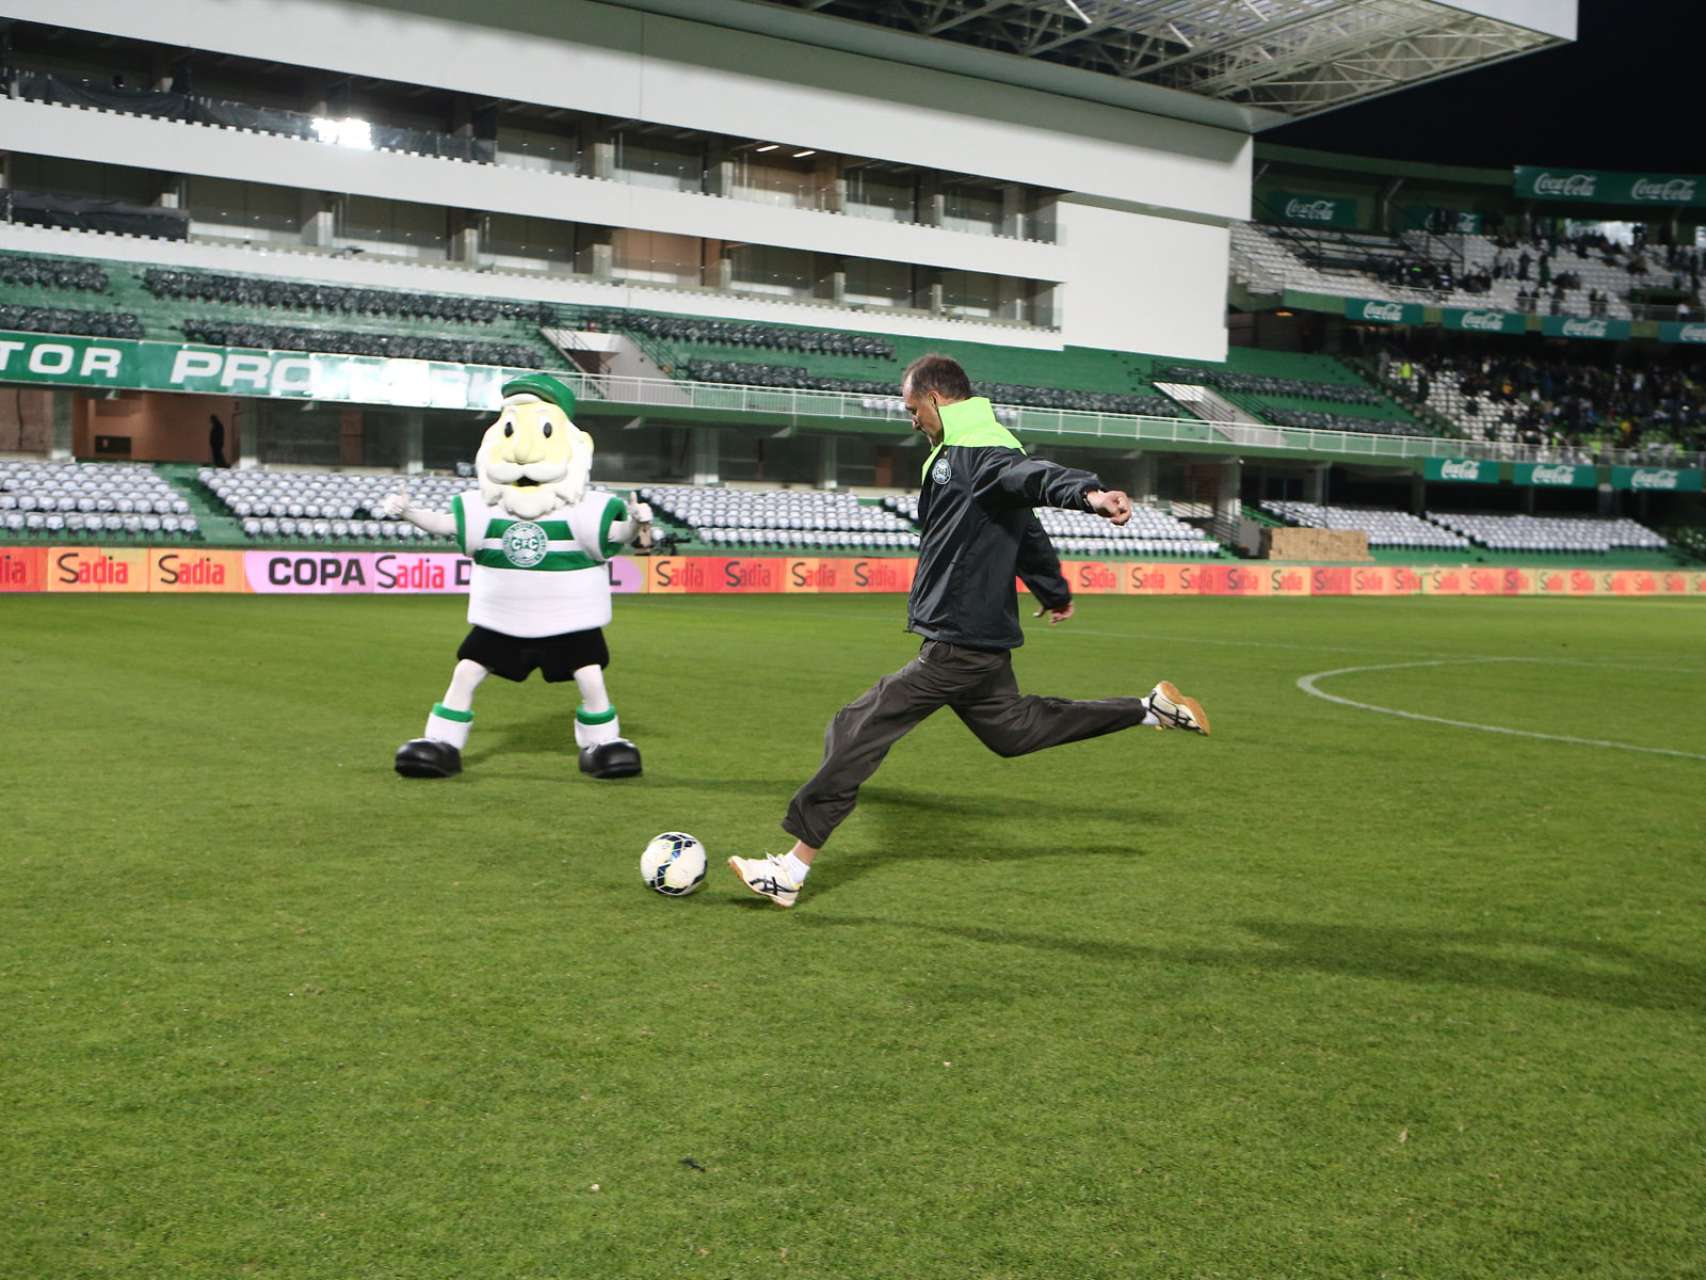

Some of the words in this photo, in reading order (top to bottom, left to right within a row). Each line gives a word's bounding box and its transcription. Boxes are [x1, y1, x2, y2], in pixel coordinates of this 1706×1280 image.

[170, 349, 317, 391] PRO
[57, 552, 128, 584] Sadia
[158, 554, 225, 585] Sadia
[268, 557, 365, 586] COPA
[375, 555, 444, 589] Sadia
[655, 560, 704, 587] Sadia
[724, 560, 771, 588] Sadia
[791, 561, 836, 588] Sadia
[853, 561, 897, 588] Sadia
